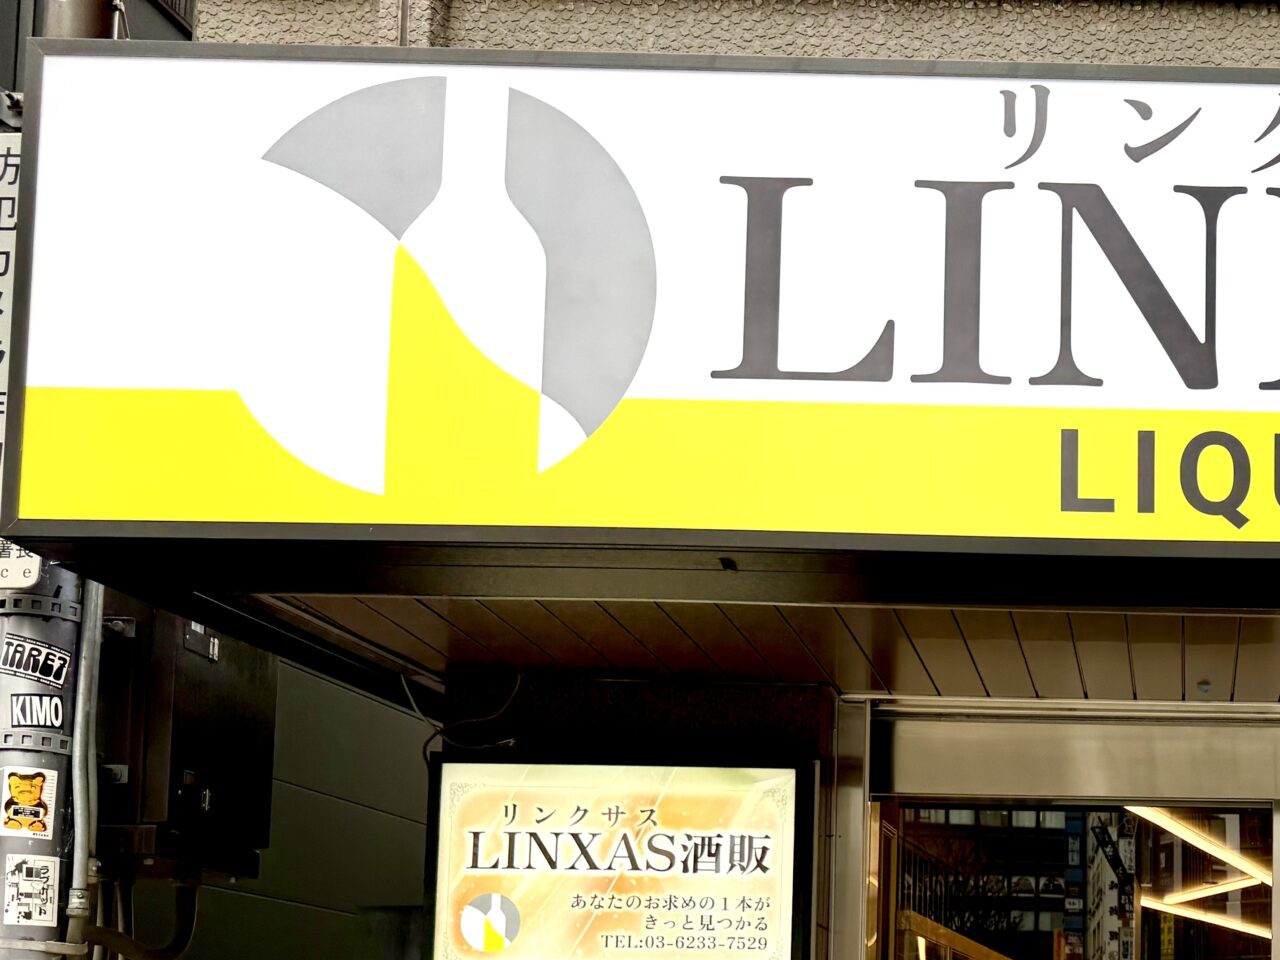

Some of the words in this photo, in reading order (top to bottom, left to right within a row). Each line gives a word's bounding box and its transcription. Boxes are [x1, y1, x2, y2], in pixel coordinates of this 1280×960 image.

[11, 695, 63, 728] KIMO
[503, 803, 658, 828] リンクサス
[644, 914, 768, 932] きっと見つかる
[601, 935, 769, 951] TEL:03-6233-7529
